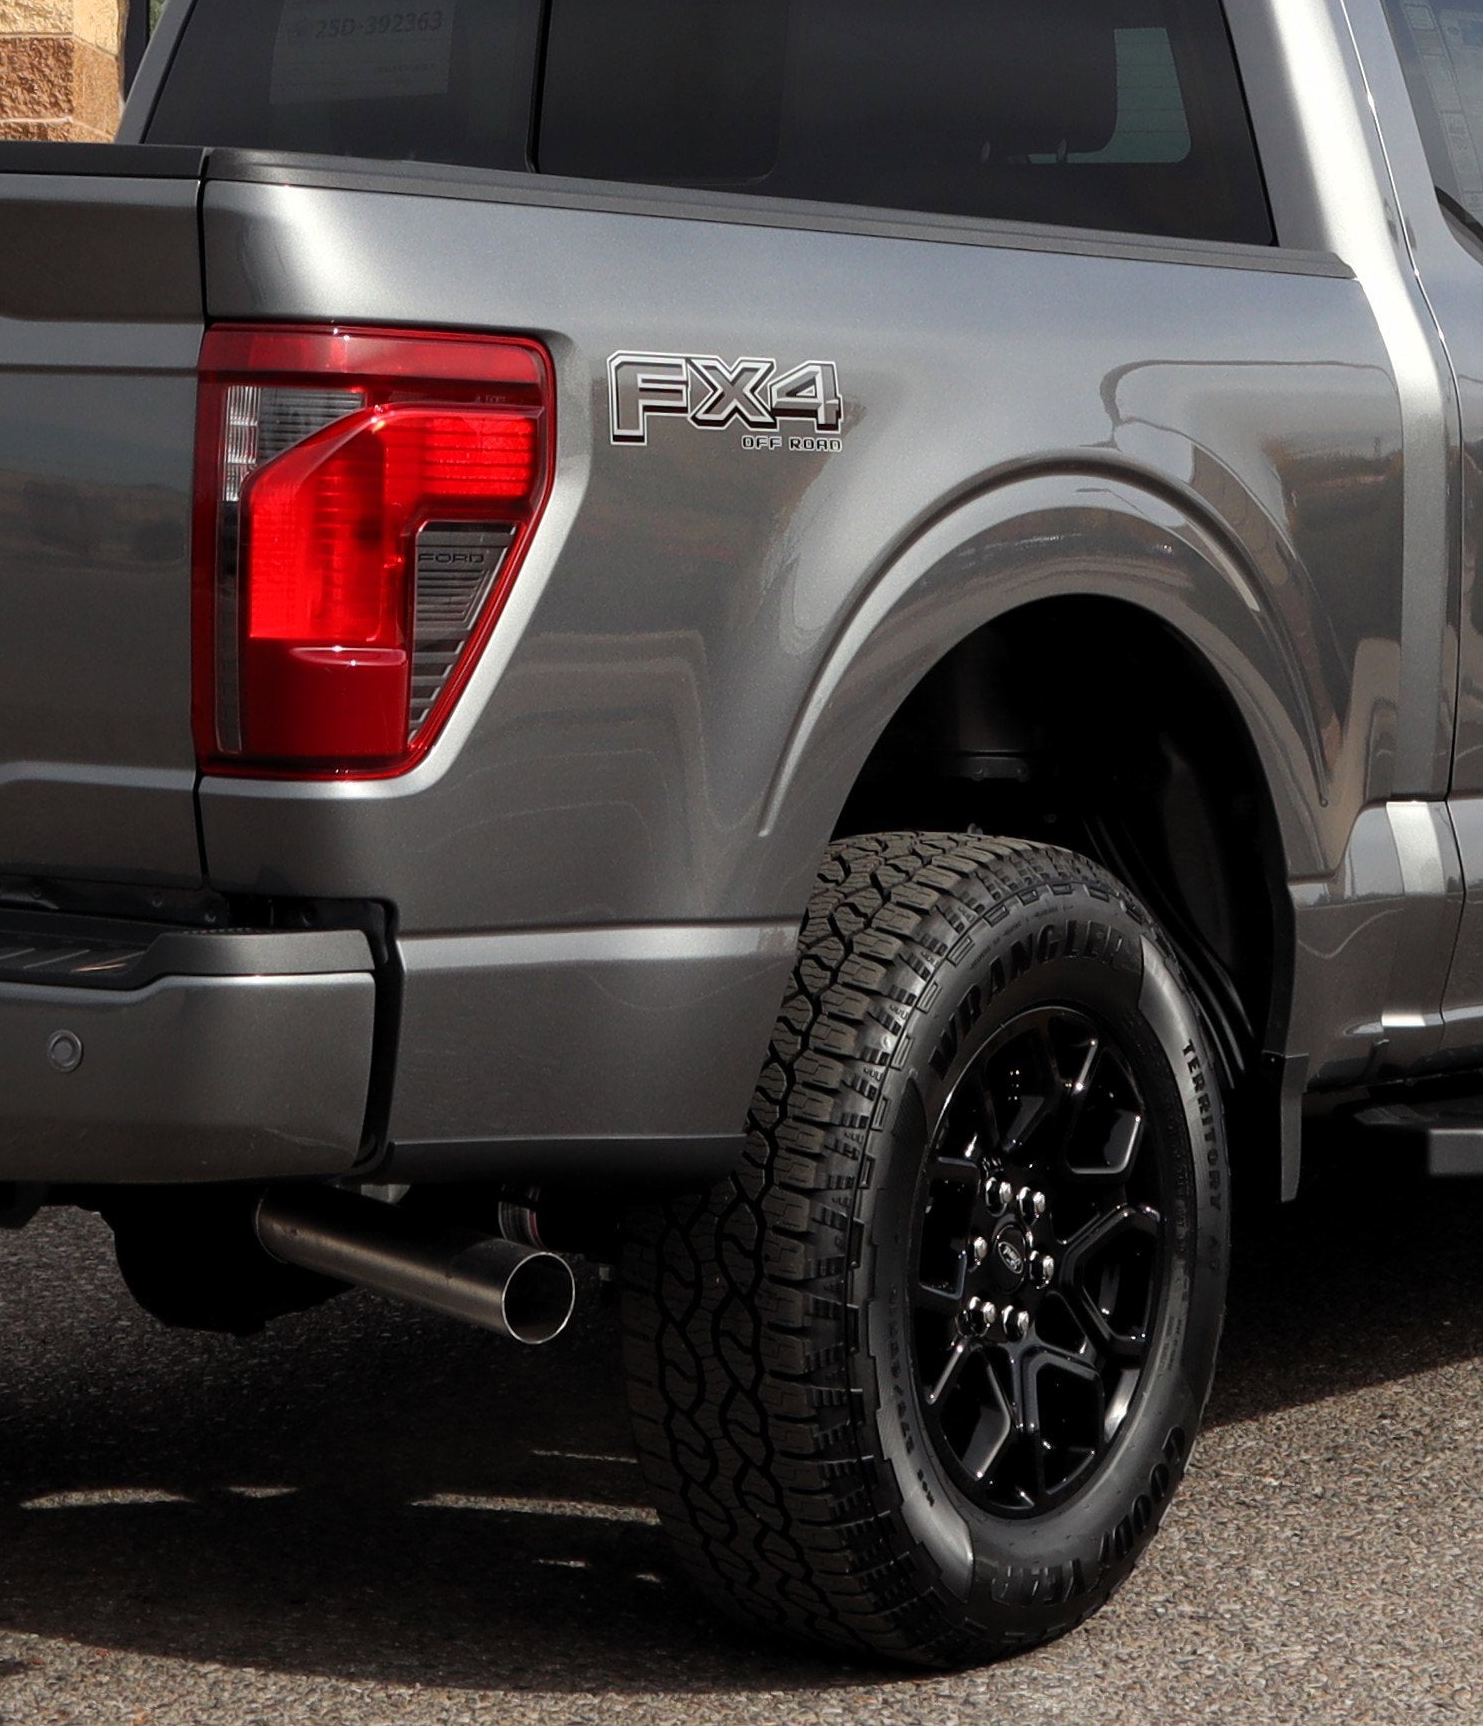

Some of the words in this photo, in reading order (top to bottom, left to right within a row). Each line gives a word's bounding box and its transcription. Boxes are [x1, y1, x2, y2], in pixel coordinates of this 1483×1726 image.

[607, 350, 844, 445] FX4
[741, 434, 783, 450] OFF
[789, 436, 843, 452] ROAD
[418, 552, 484, 564] FORD
[928, 917, 1130, 1083] WRANGLER
[1182, 1039, 1222, 1212] TERRITORY
[990, 1426, 1186, 1607] GOODYEAR
